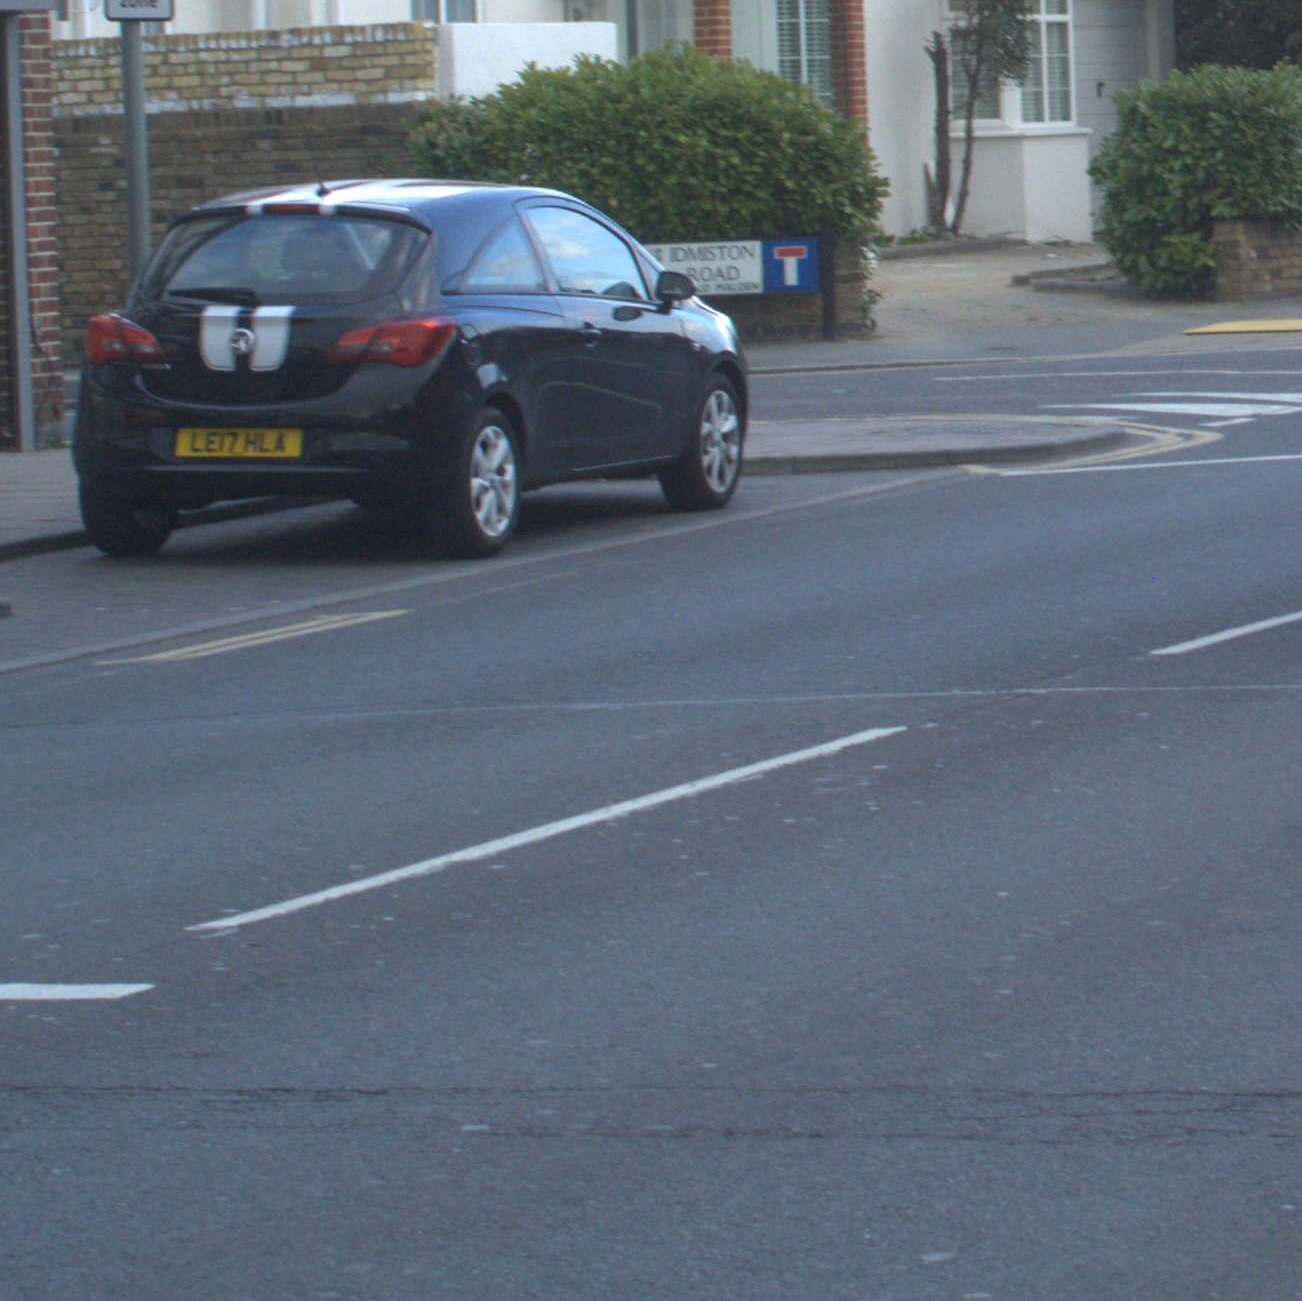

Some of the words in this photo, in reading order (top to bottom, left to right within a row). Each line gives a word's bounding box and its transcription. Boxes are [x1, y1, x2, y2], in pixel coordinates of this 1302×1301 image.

[669, 244, 757, 262] IDMISTON
[686, 265, 741, 282] ROAD
[189, 431, 240, 454] LE17
[243, 431, 286, 454] HLA
